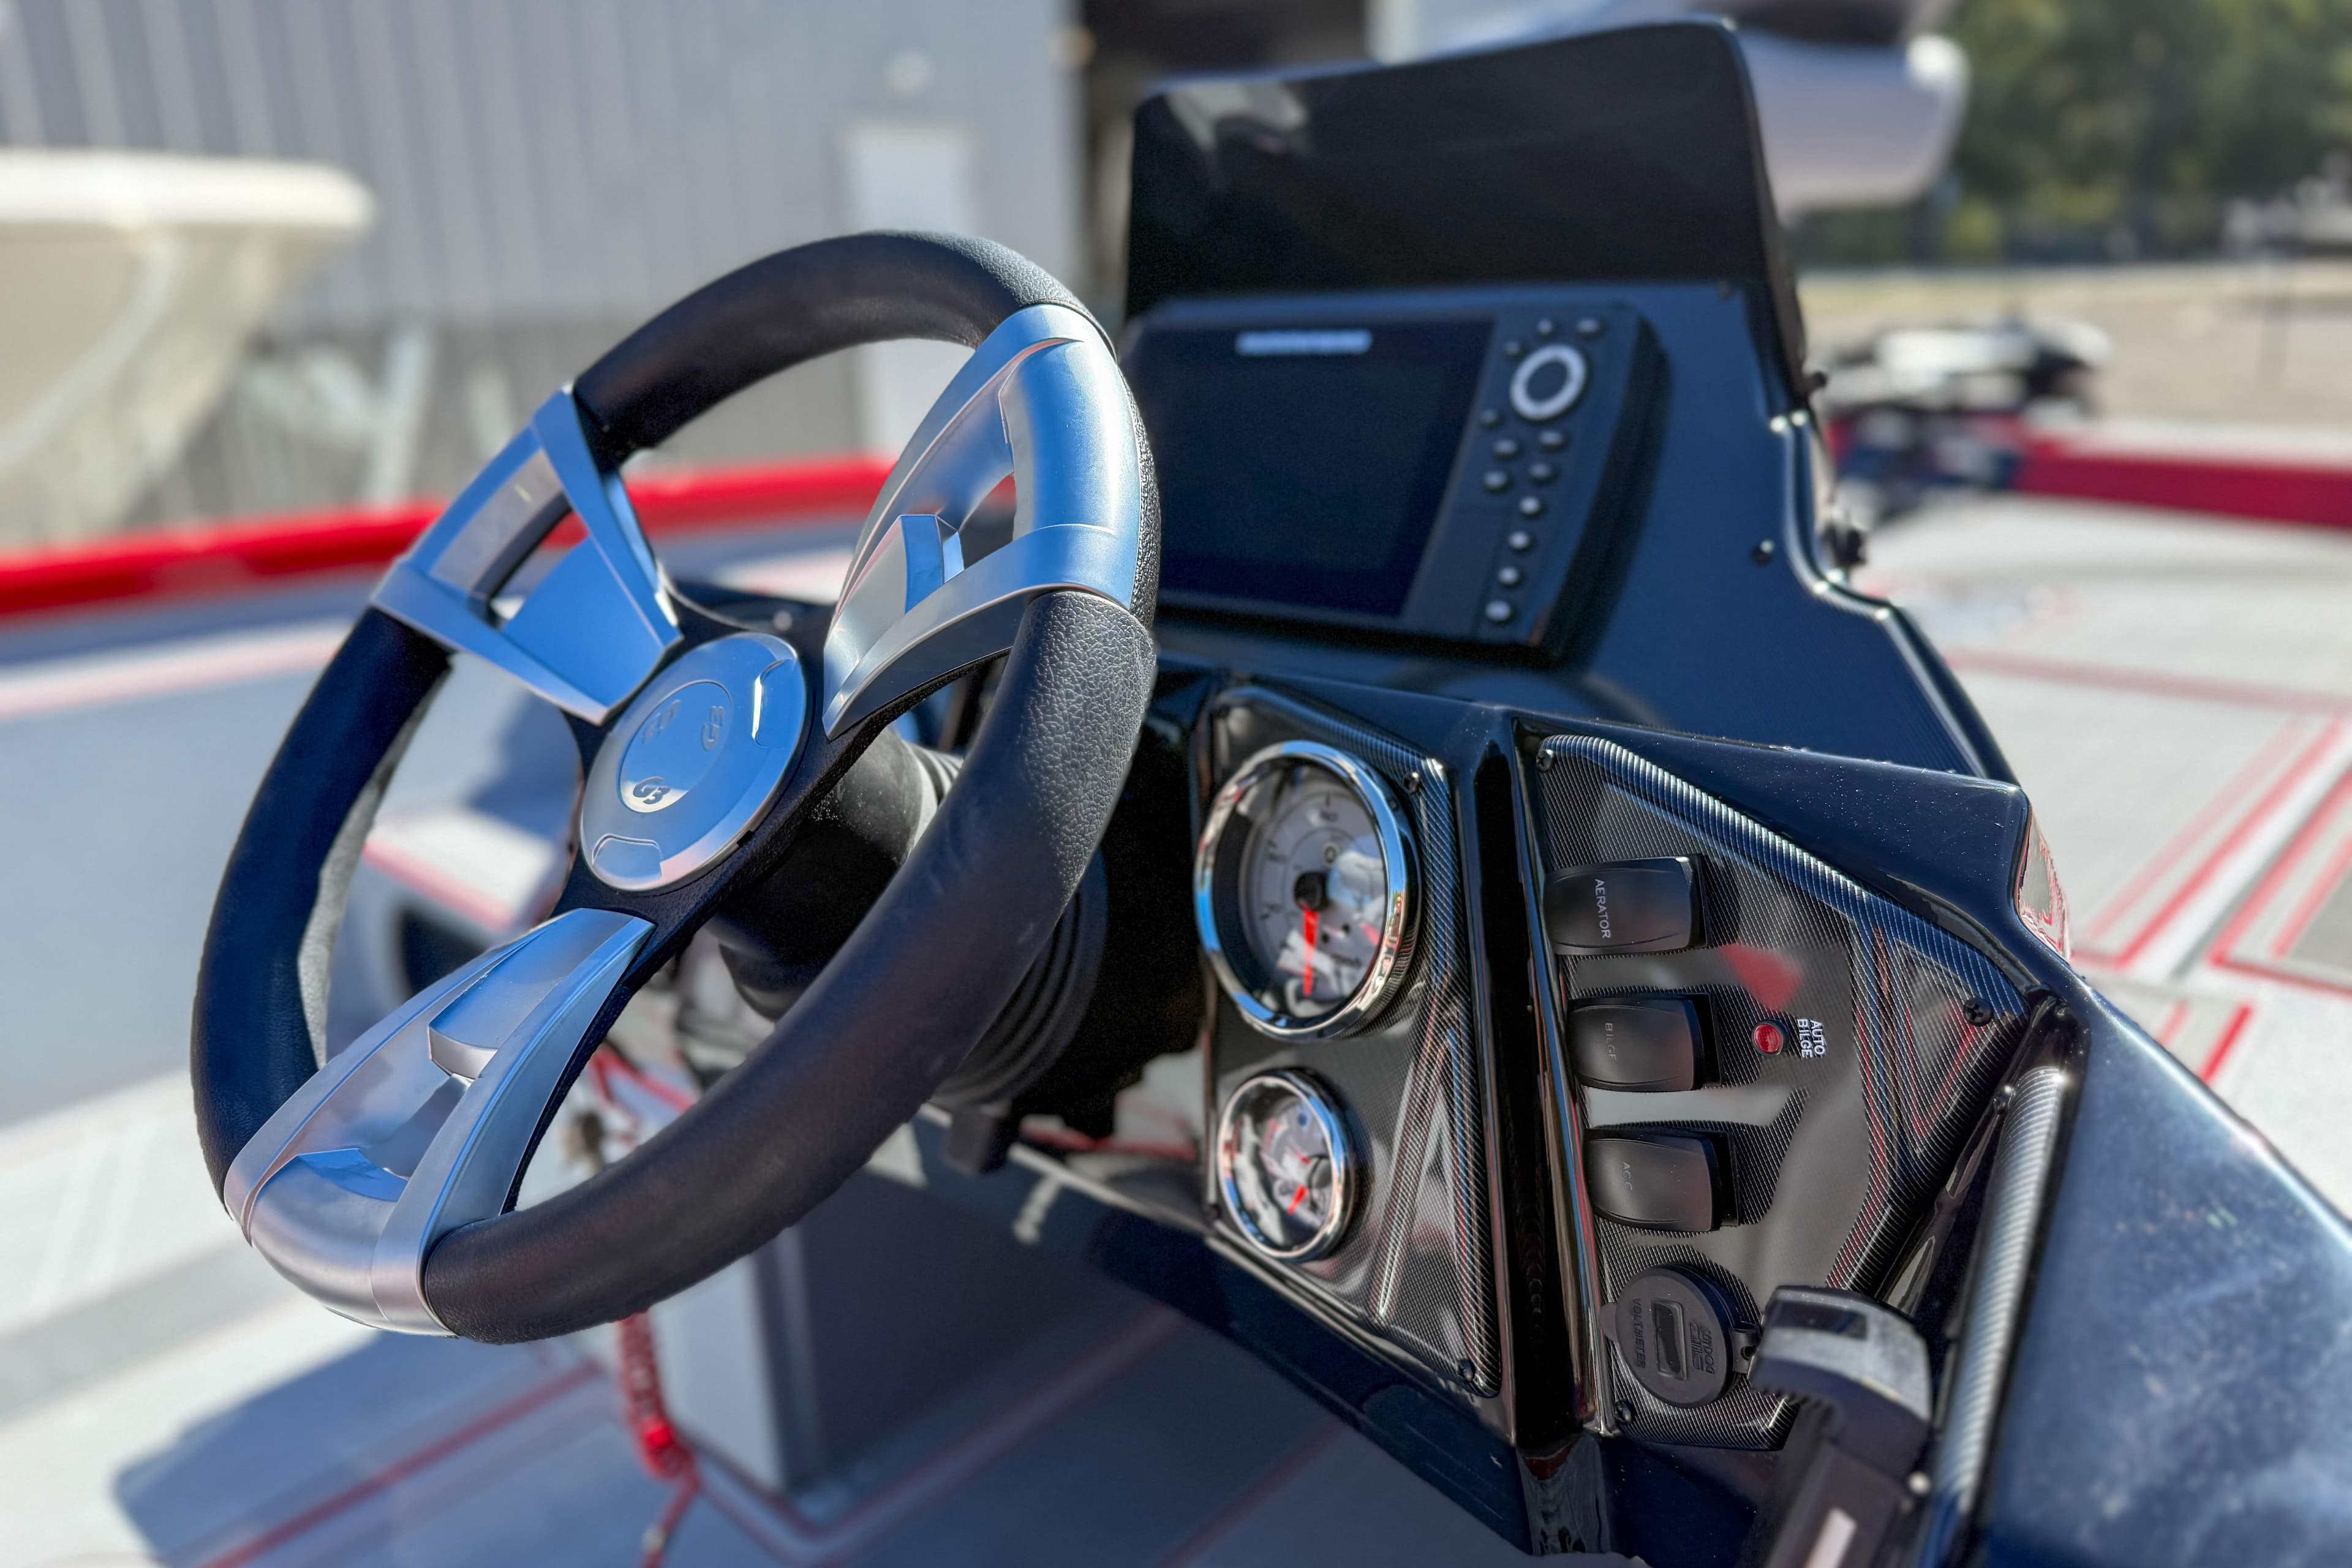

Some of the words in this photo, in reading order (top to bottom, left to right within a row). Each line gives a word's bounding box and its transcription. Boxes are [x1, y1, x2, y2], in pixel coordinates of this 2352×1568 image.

[1594, 878, 1611, 938] AERATOR
[1796, 1019, 1814, 1058] BILGE
[1810, 1020, 1826, 1055] AUTO
[1623, 1161, 1633, 1191] ACC
[1632, 1297, 1646, 1368] VOLTMETER
